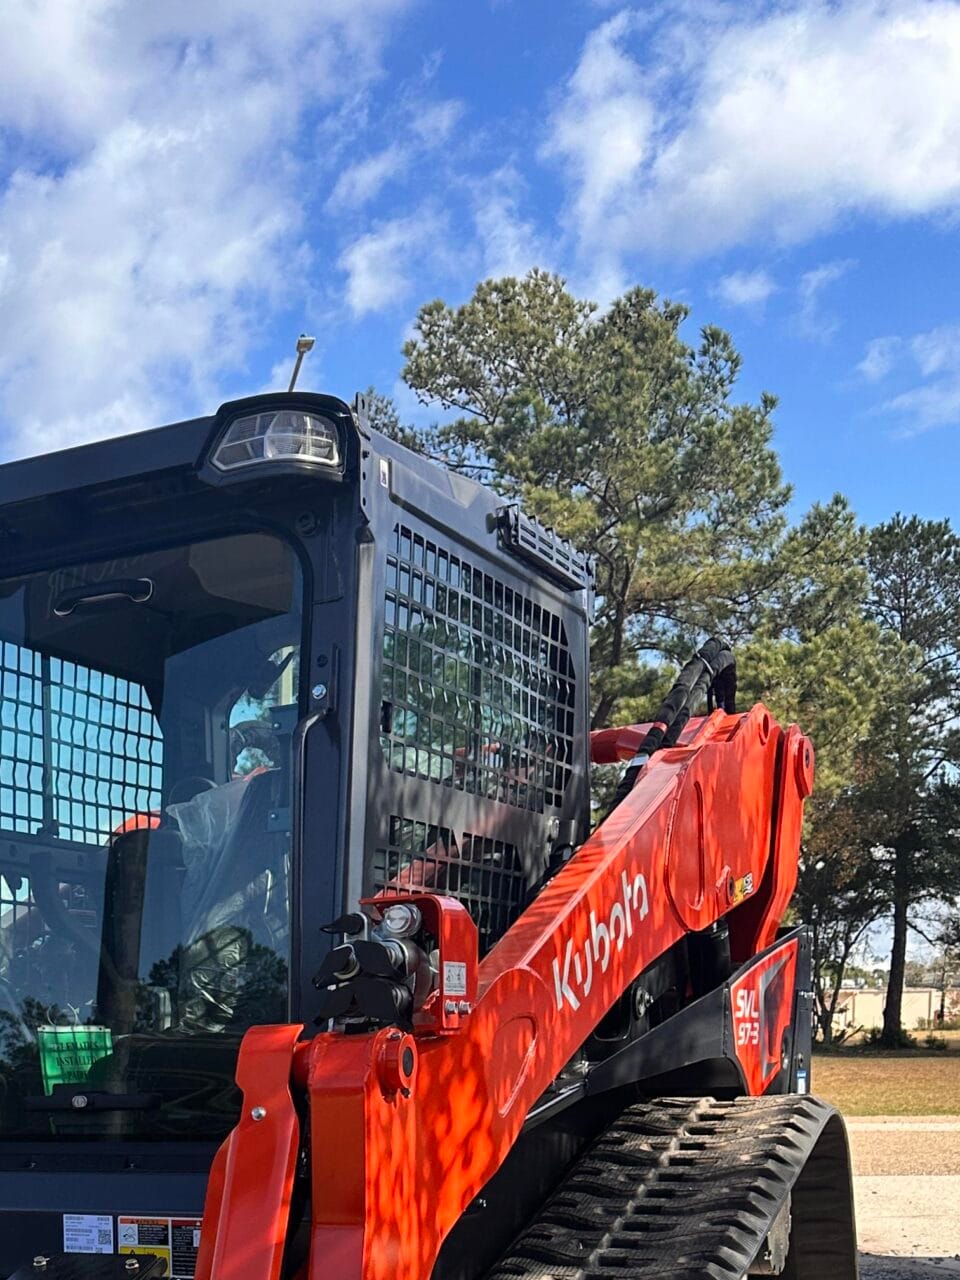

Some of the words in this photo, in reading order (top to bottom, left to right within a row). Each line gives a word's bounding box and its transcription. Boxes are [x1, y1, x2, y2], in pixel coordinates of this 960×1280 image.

[552, 869, 649, 1011] Kubota
[735, 988, 759, 1018] SVL
[737, 1022, 760, 1046] 97-3
